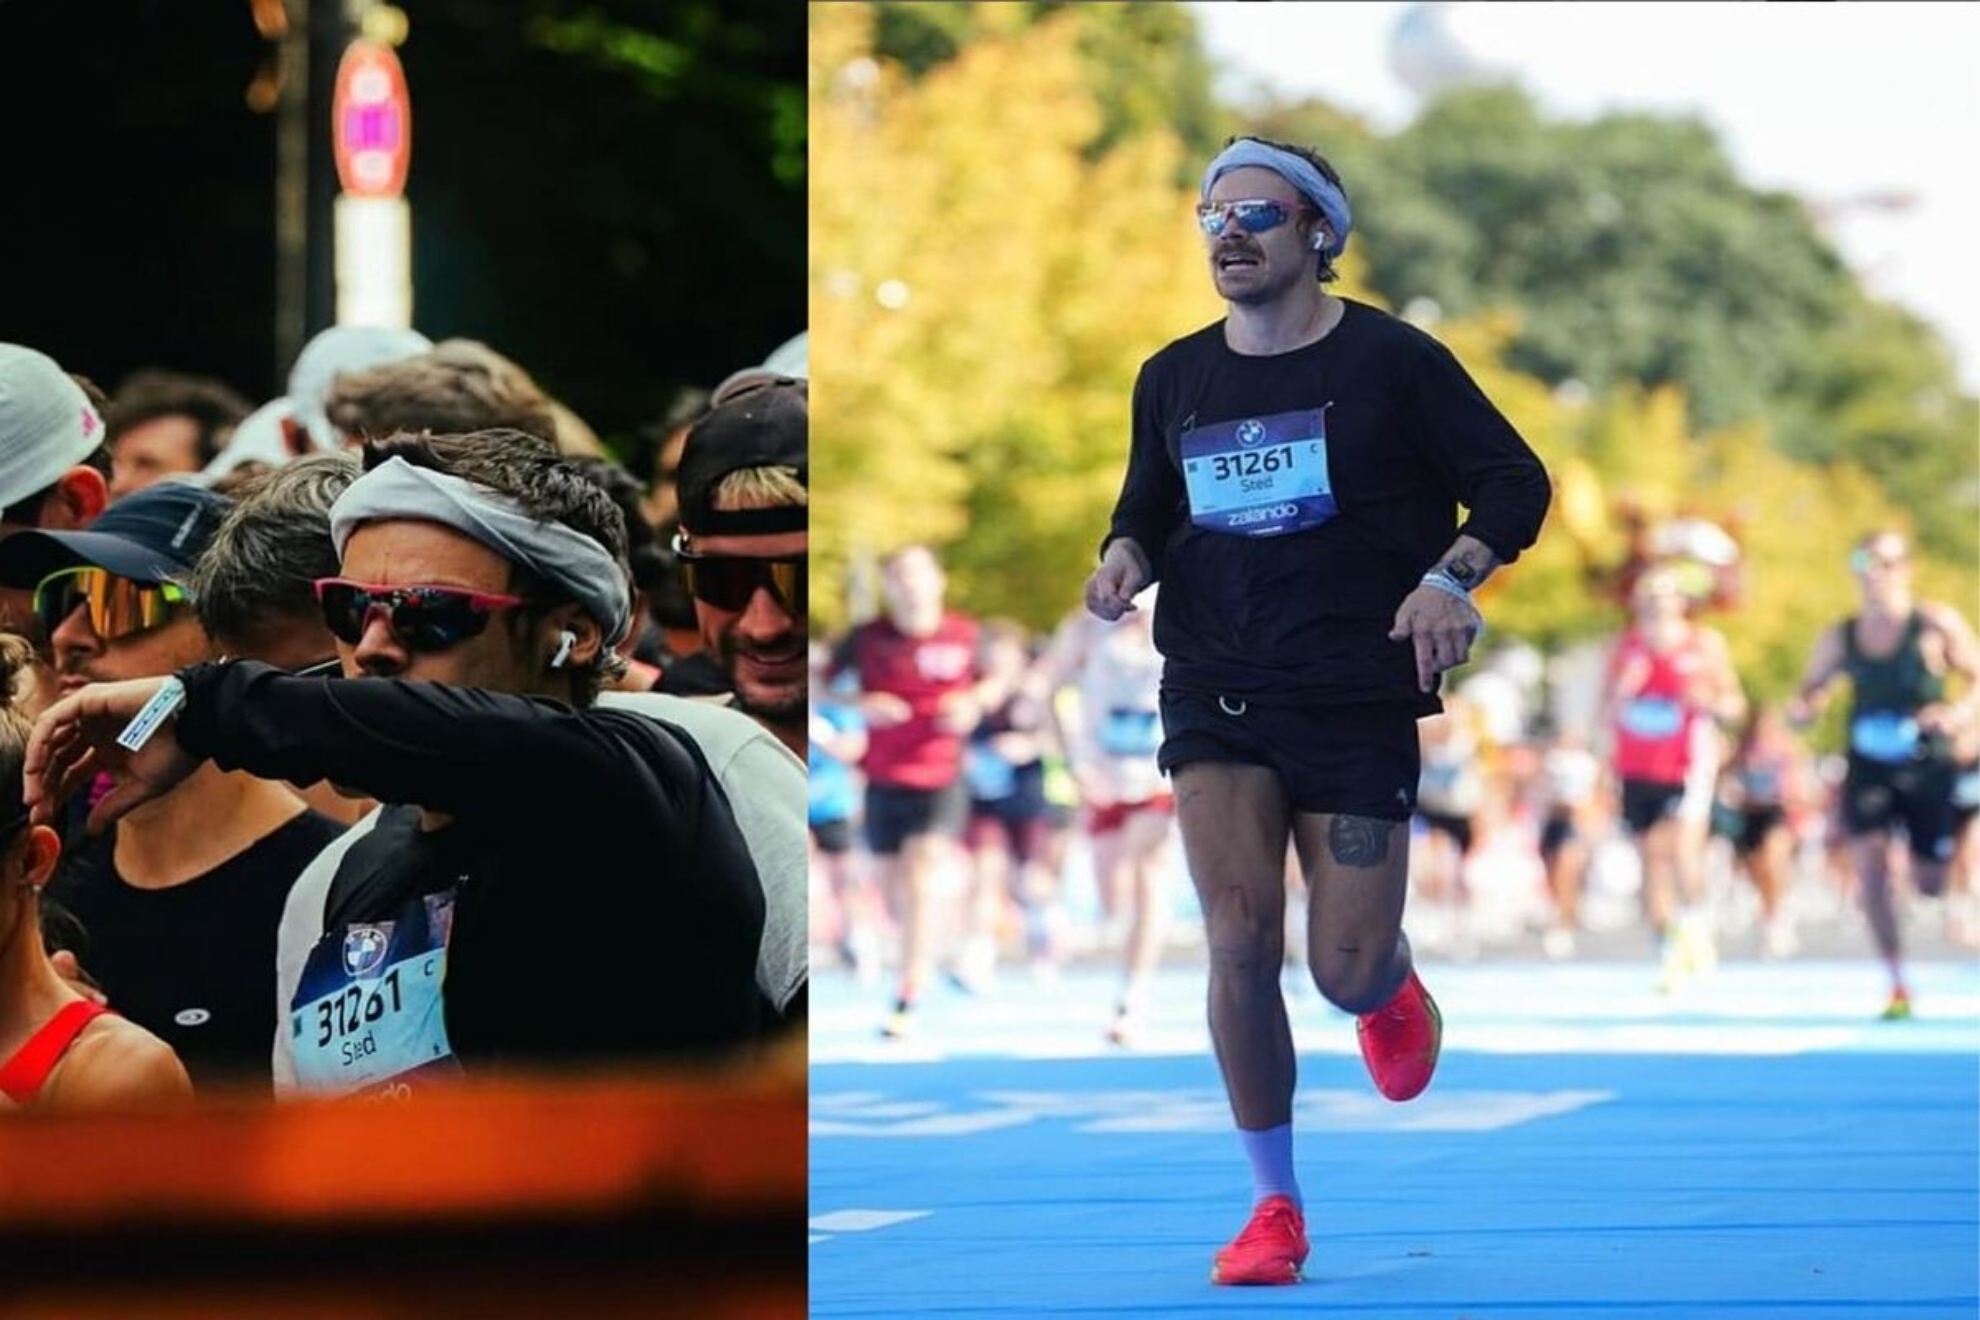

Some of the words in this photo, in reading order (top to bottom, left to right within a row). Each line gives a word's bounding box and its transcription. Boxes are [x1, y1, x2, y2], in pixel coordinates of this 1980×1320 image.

[1310, 443, 1318, 454] C
[1212, 446, 1294, 481] 31261
[1240, 476, 1274, 494] Sted
[1227, 503, 1299, 526] zalando
[424, 958, 435, 977] C
[318, 968, 401, 1048] 31261
